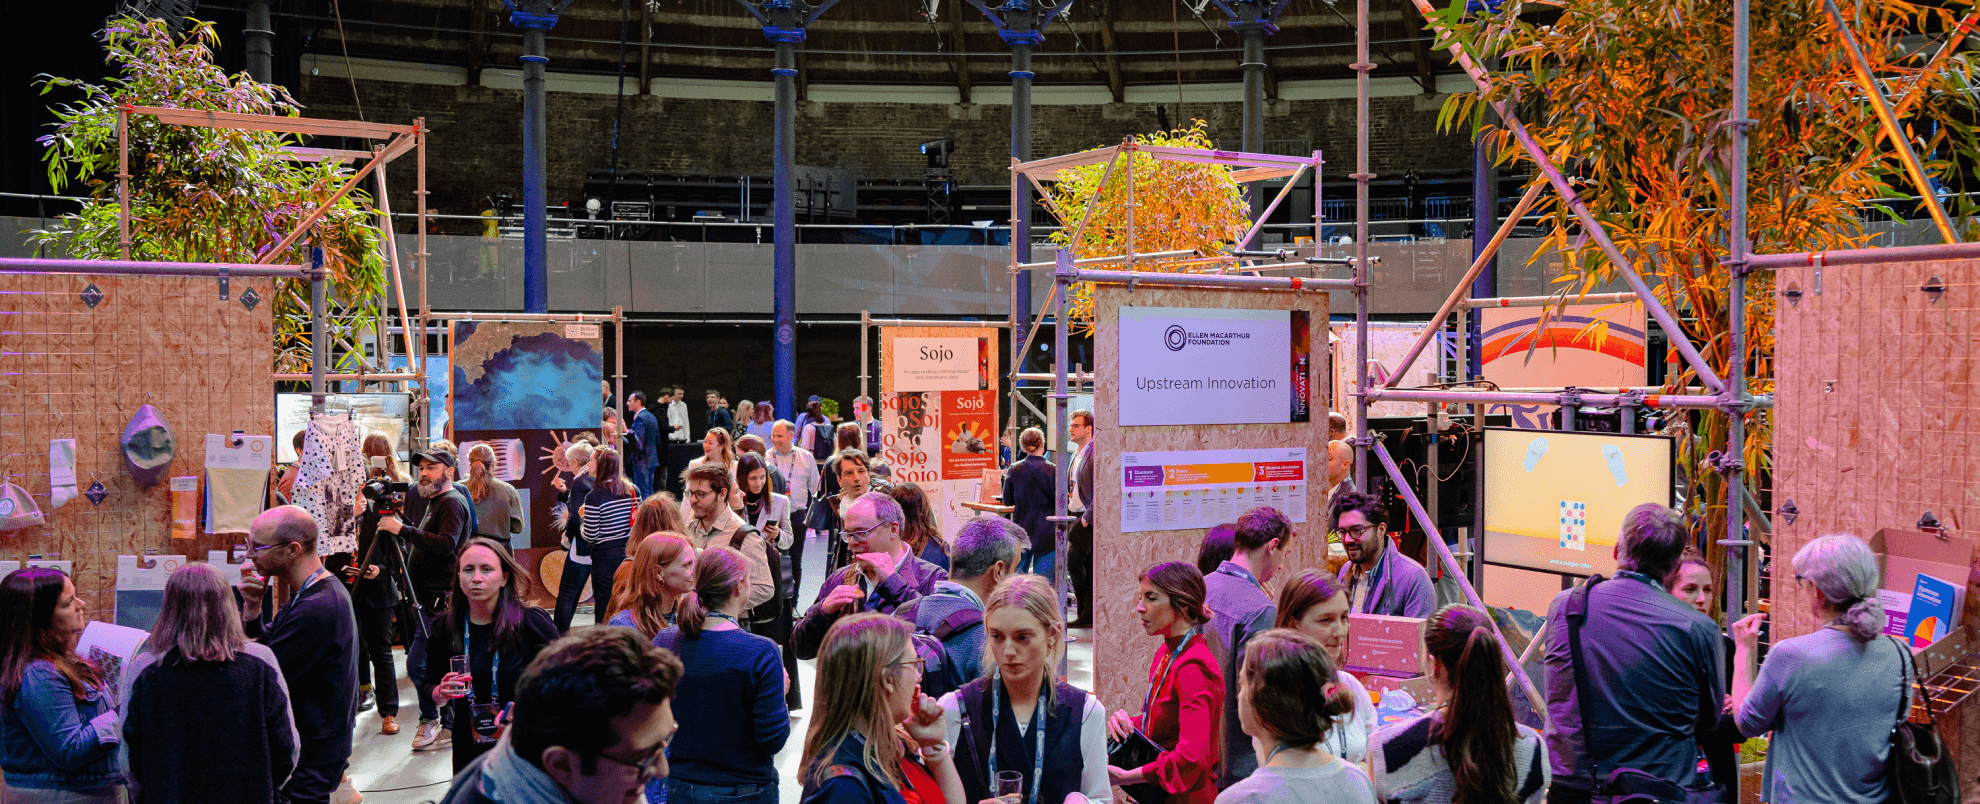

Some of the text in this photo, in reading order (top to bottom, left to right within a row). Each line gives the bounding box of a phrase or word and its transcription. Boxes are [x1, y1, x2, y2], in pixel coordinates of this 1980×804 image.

[920, 345, 953, 363] Sojo
[1136, 377, 1276, 392] Upstream Innovation
[957, 396, 984, 410] Sojo
[885, 446, 927, 468] Sojo
[1128, 470, 1132, 480] 1
[1169, 469, 1175, 478] 2
[1259, 466, 1264, 475] 3
